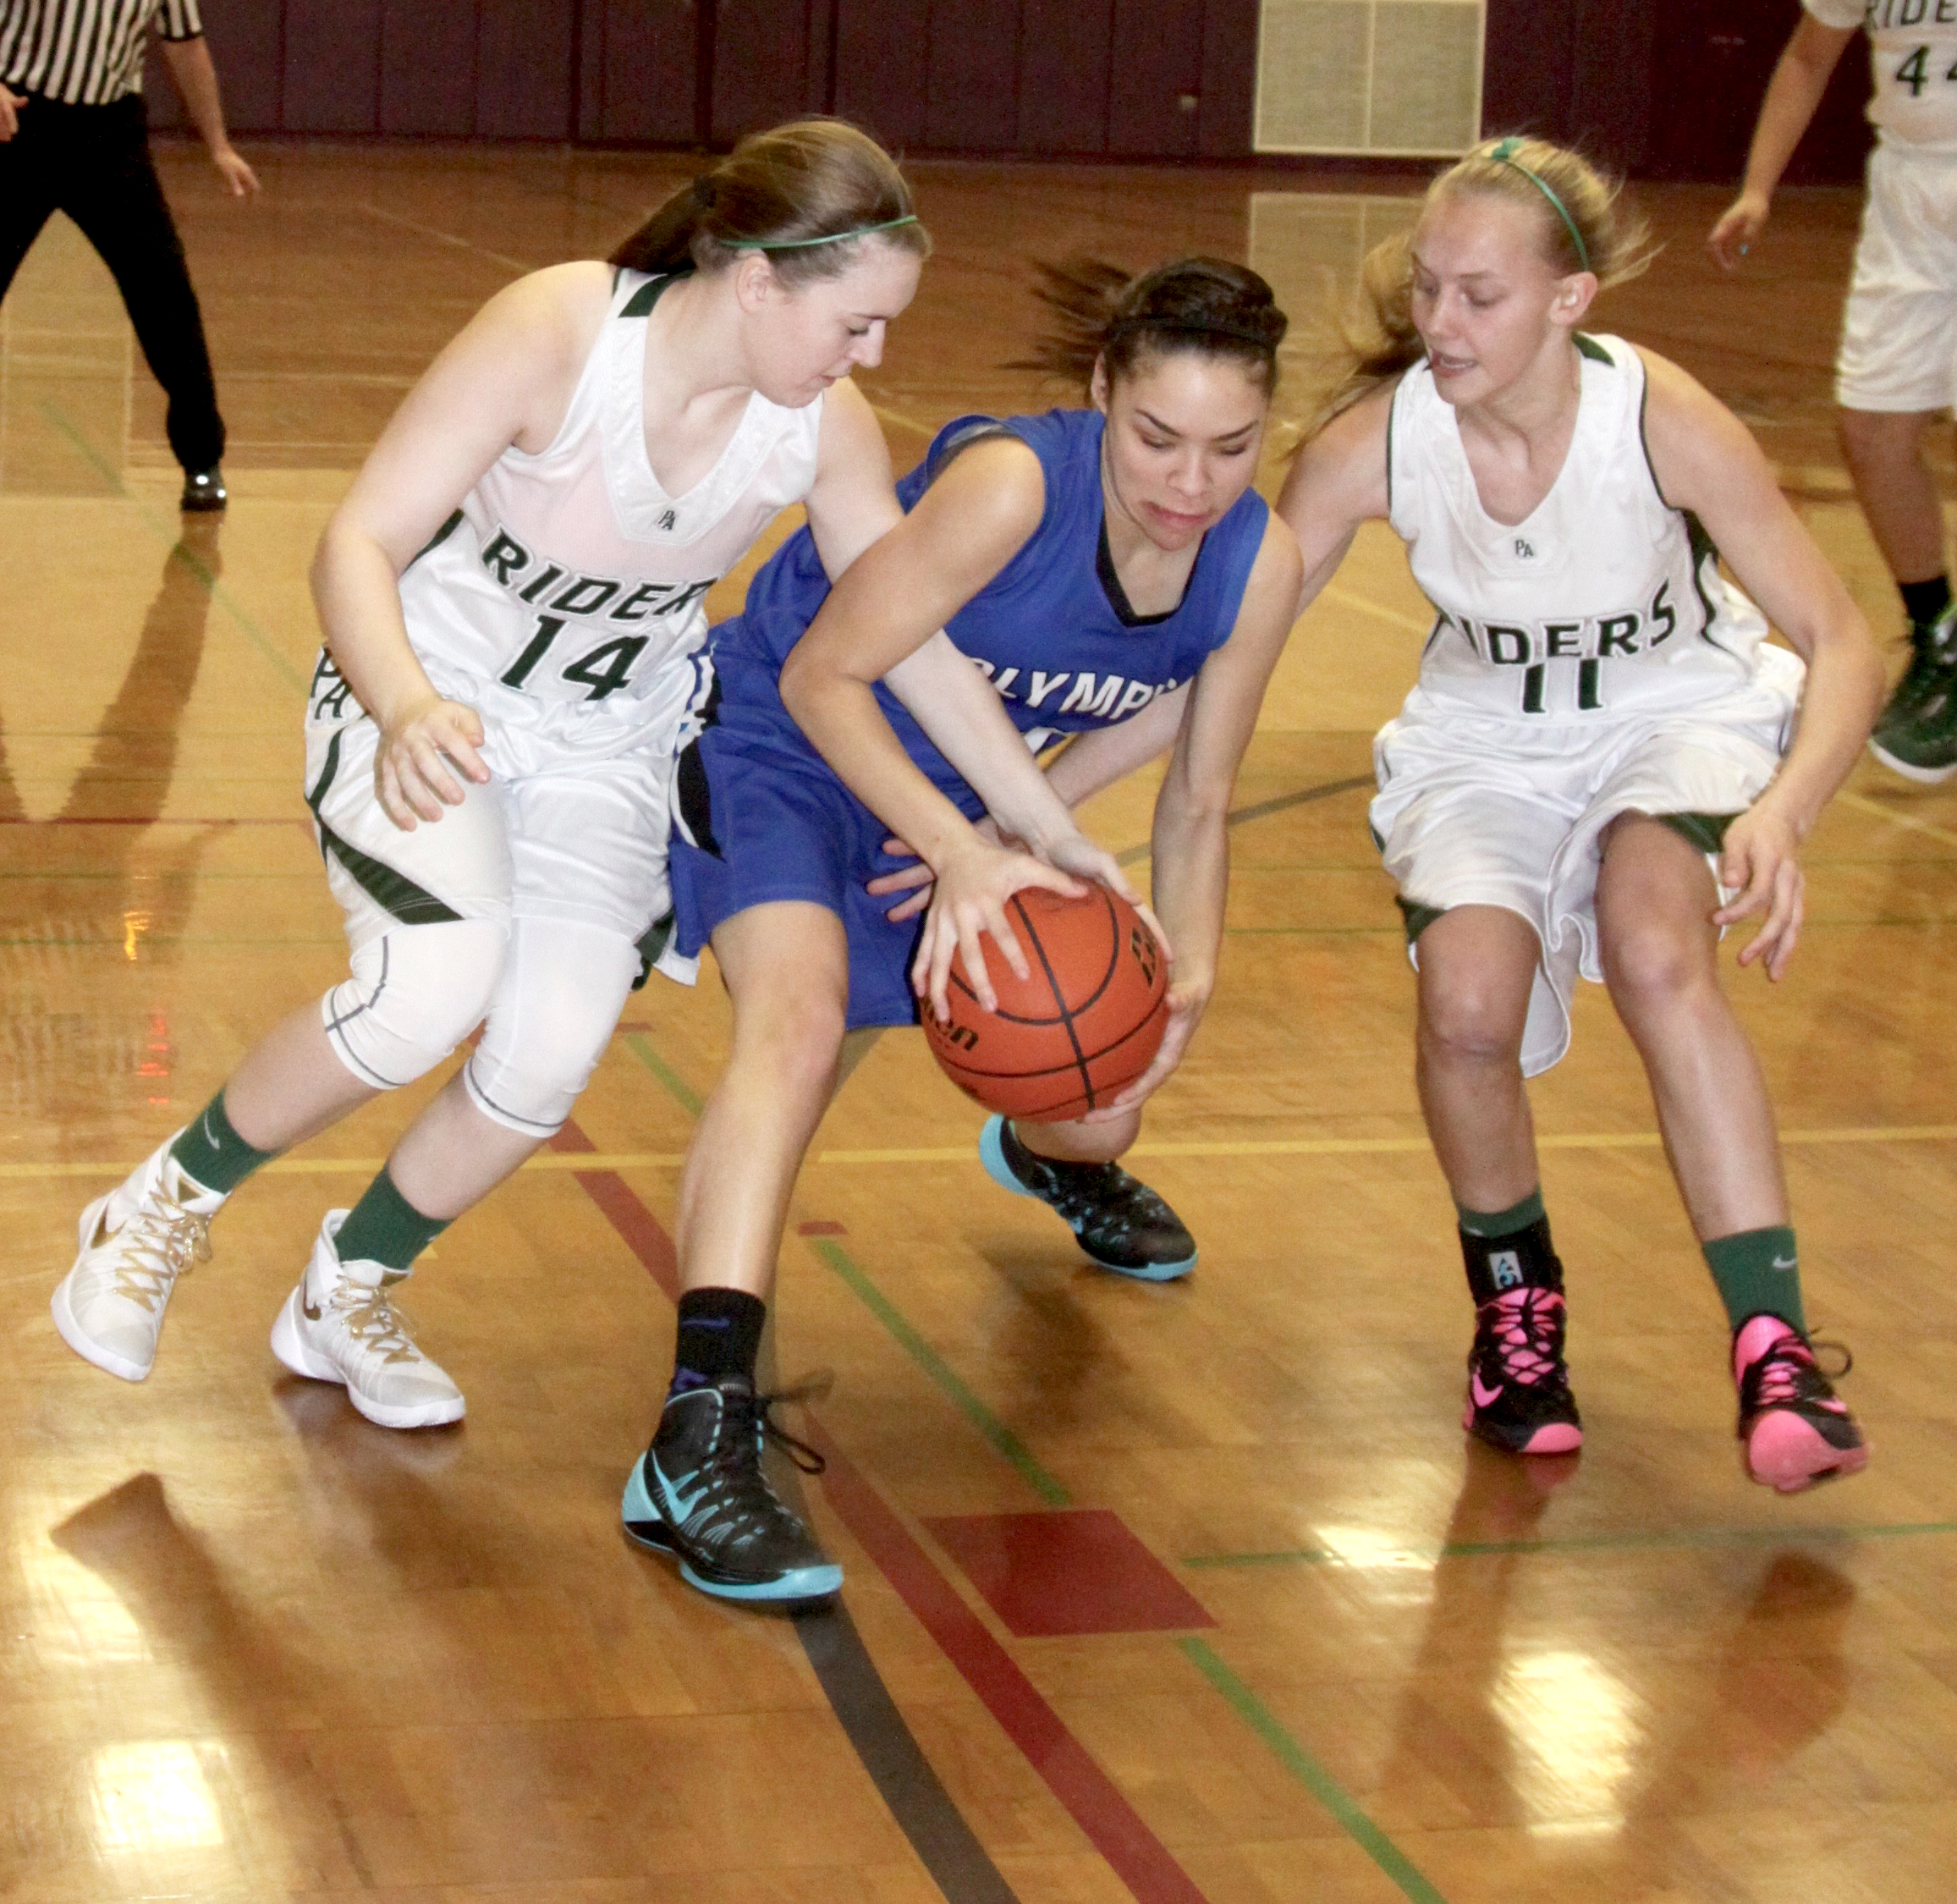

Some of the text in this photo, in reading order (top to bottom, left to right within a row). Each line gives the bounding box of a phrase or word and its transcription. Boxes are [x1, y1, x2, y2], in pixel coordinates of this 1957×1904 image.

[658, 510, 676, 531] PA
[1514, 539, 1534, 558] PA
[499, 614, 651, 702] 14
[1522, 658, 1603, 713] 11
[973, 658, 1178, 720] LYMP
